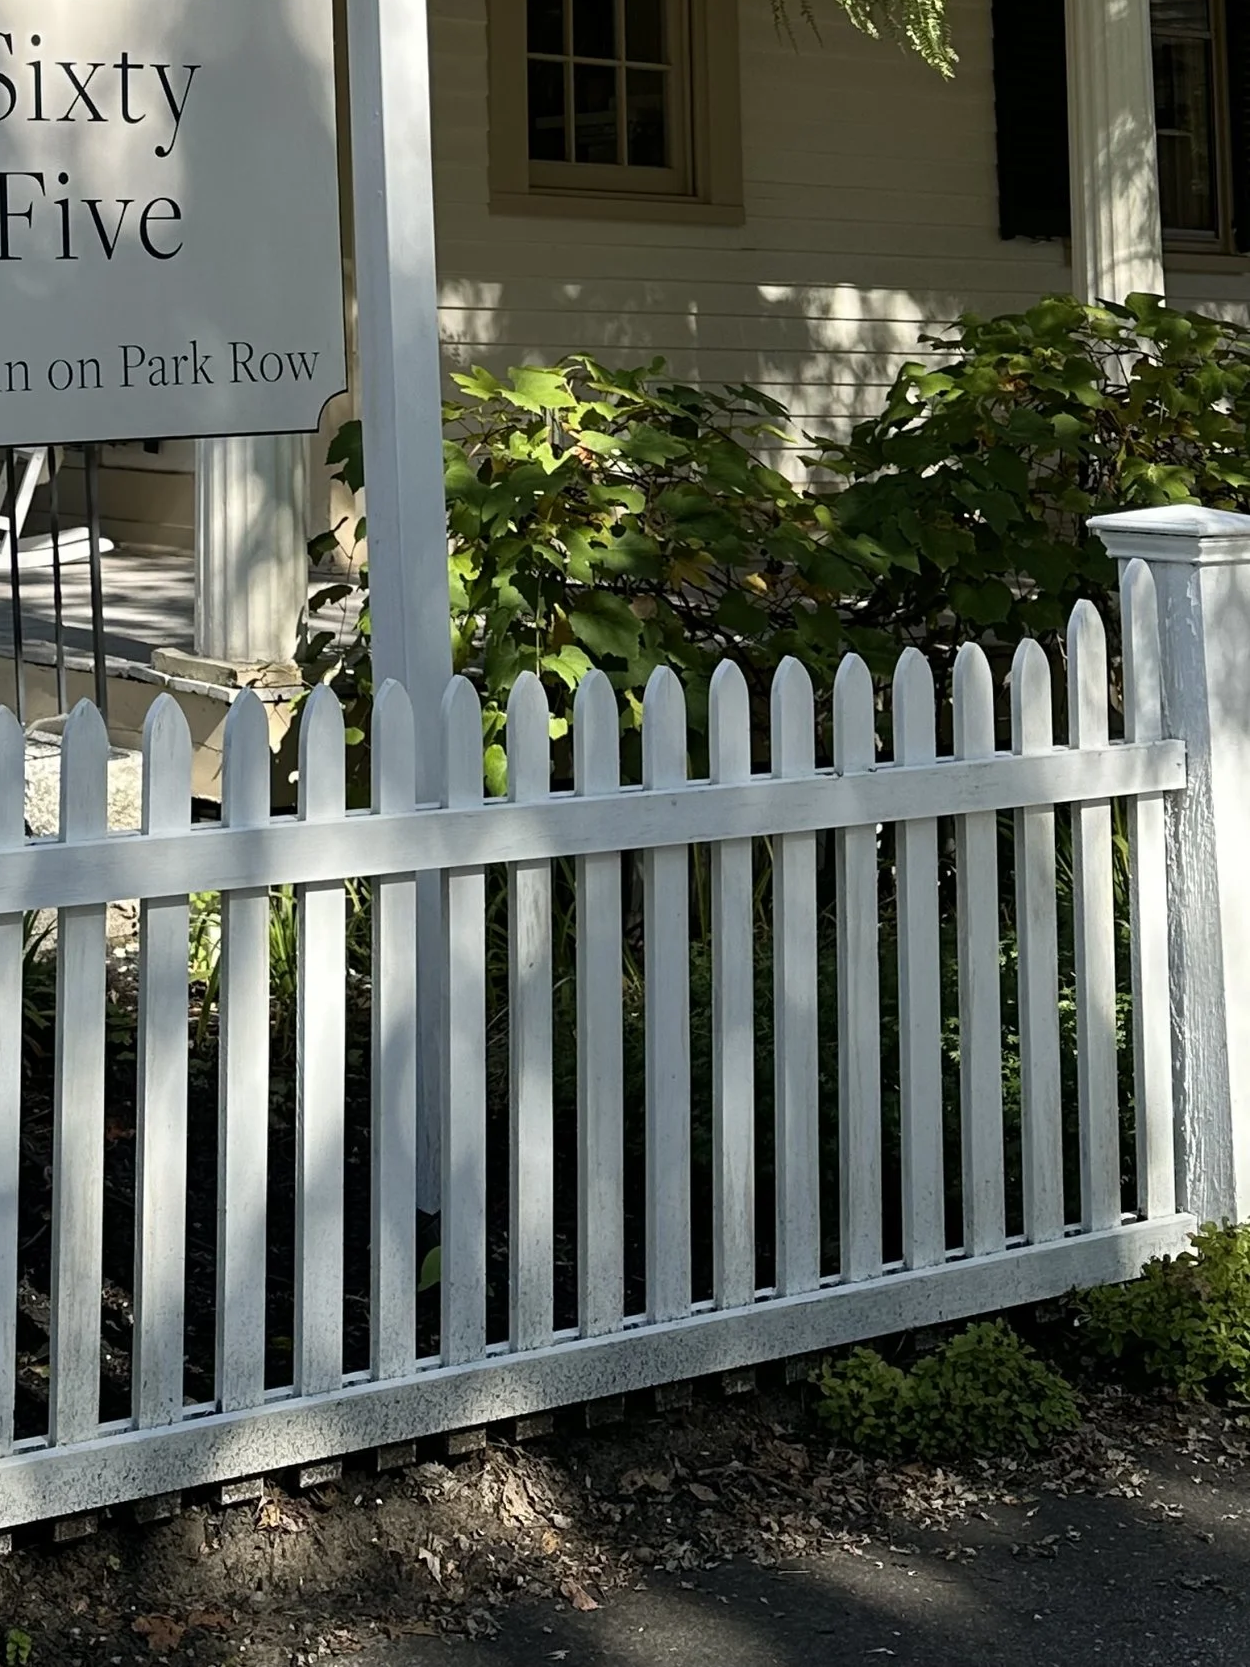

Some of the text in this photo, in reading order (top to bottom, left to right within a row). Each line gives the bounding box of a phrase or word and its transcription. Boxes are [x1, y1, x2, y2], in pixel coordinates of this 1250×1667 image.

[48, 359, 104, 391] on
[119, 338, 215, 388] Park
[228, 342, 321, 384] Row
